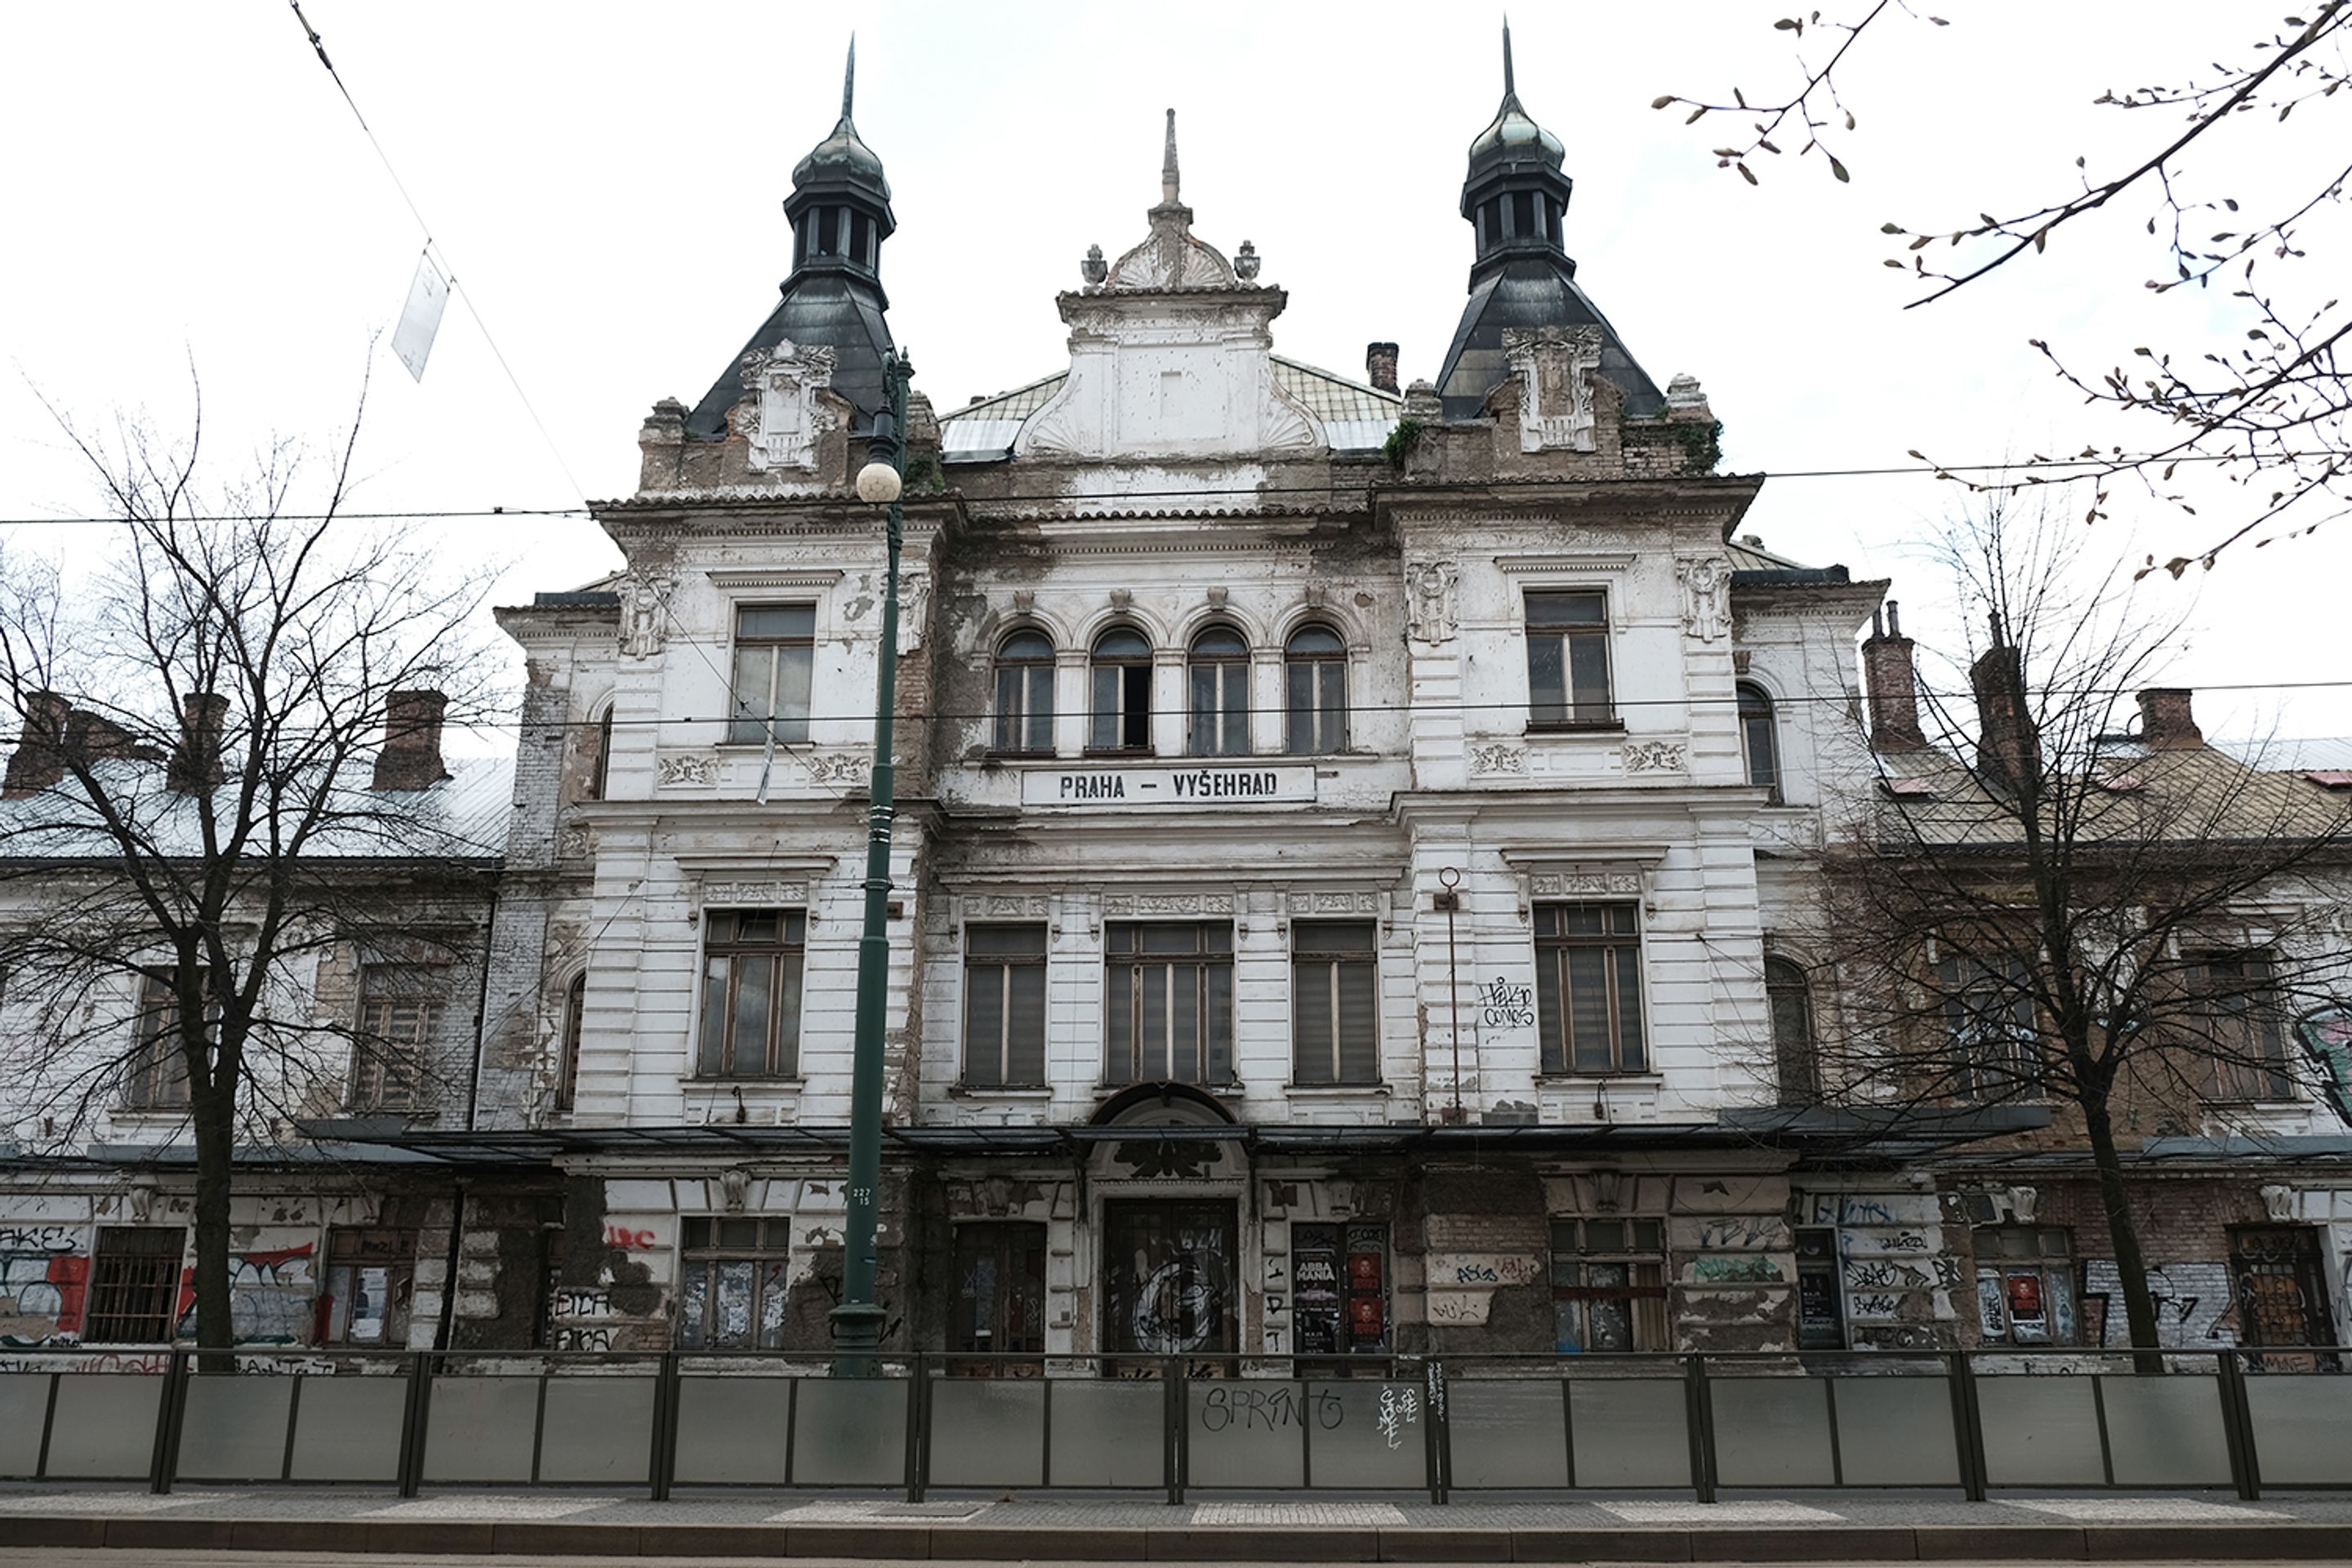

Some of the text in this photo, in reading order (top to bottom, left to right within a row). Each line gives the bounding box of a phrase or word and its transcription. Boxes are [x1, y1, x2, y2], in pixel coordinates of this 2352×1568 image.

[1060, 776, 1125, 799] PRAHA
[1173, 770, 1277, 797] VYŠEHRAD
[859, 1196, 871, 1206] 15
[1299, 1262, 1333, 1272] ABBA
[1296, 1270, 1336, 1281] MANIA
